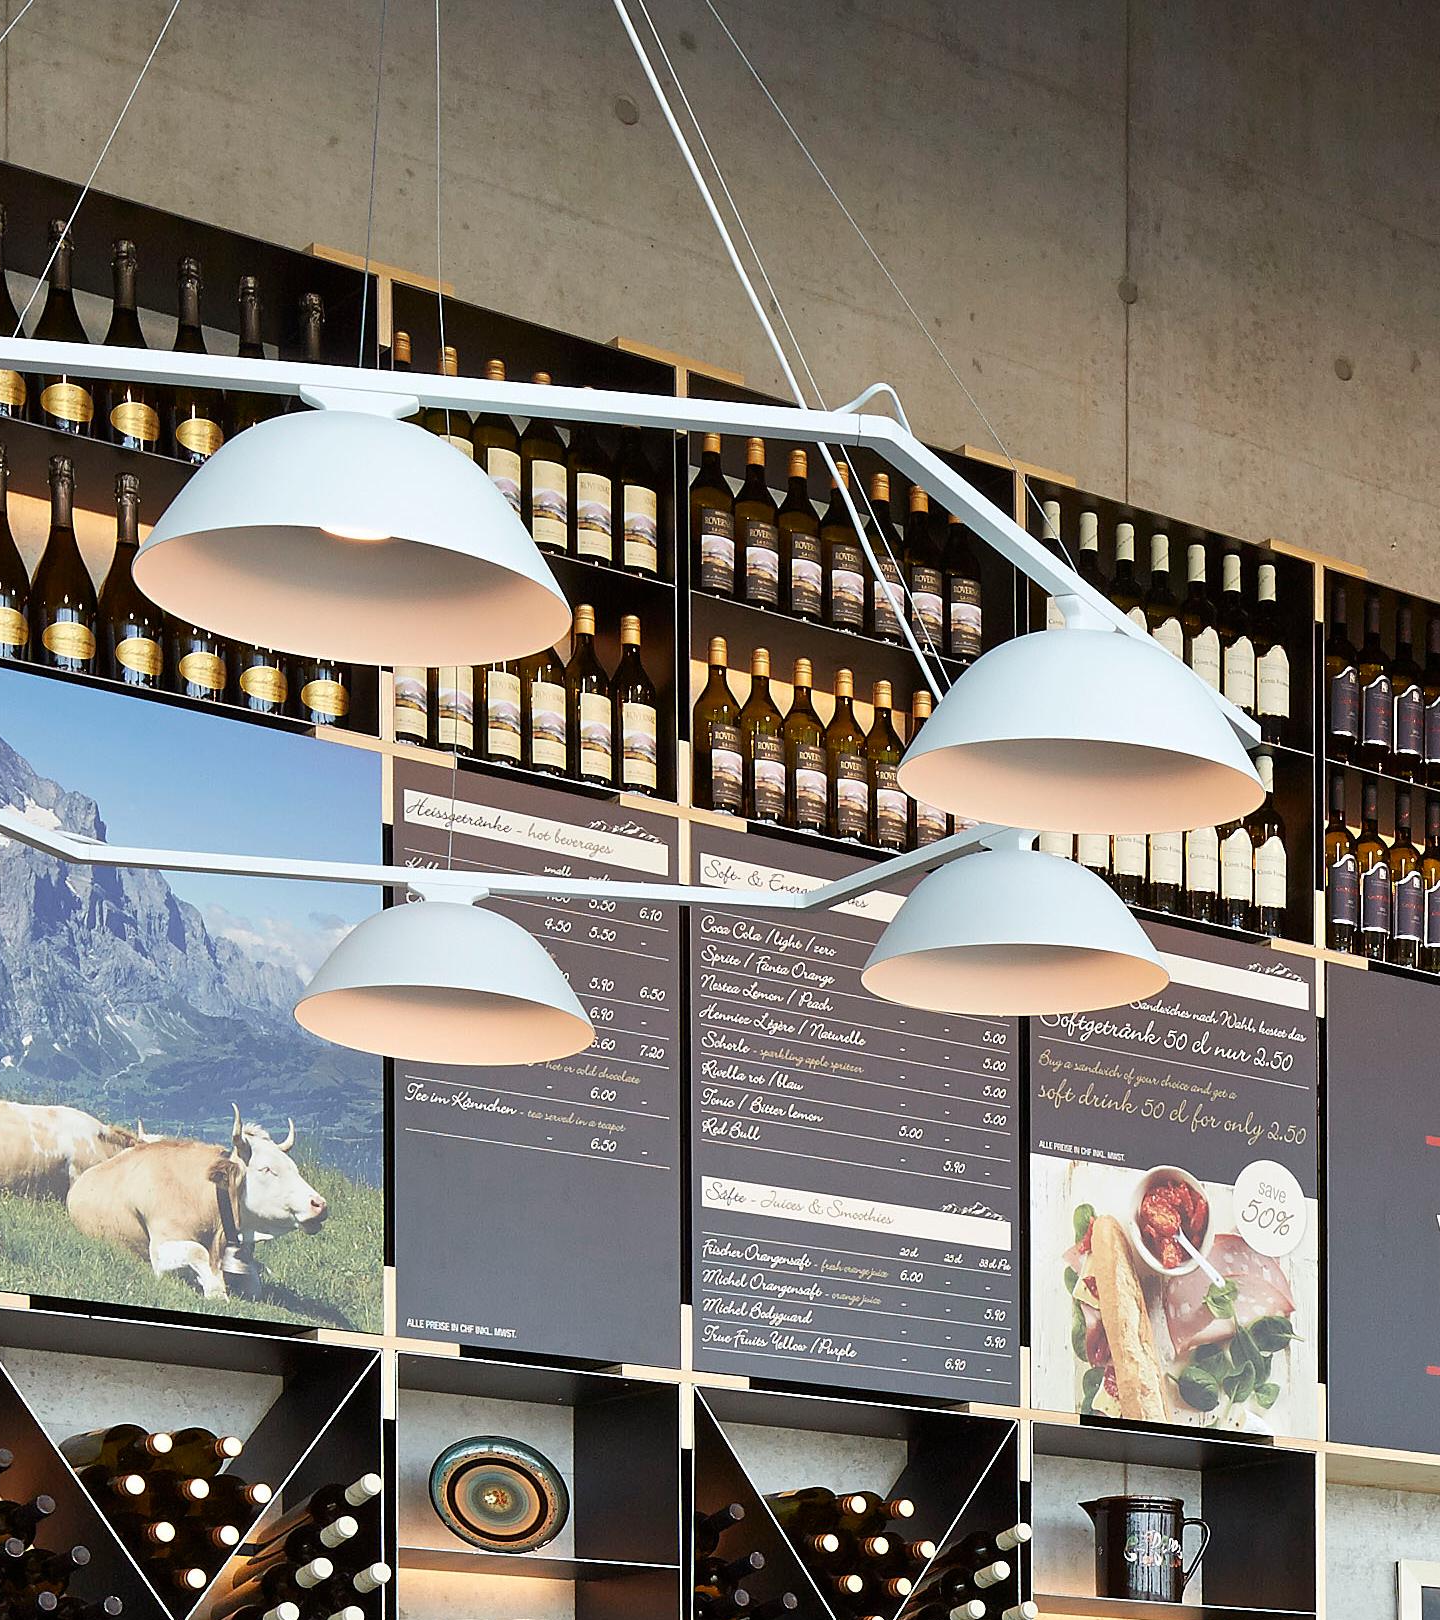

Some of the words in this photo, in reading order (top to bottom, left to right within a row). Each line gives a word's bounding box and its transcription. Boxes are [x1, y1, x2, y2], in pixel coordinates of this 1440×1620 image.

[406, 798, 512, 833] Heissgetränke
[527, 823, 552, 841] hot
[554, 829, 614, 856] beverages
[544, 866, 572, 877] small
[704, 860, 741, 880] Soft-
[589, 899, 616, 912] 5.50
[640, 908, 662, 921] 6.10
[545, 918, 571, 932] 4.50
[589, 927, 616, 941] 5.50
[701, 916, 730, 936] Coca
[732, 921, 762, 942] Cola
[701, 944, 741, 968] Sprite
[756, 955, 789, 976] Fanta
[792, 962, 836, 986] Orange
[589, 978, 614, 992] 5.90
[640, 987, 665, 1001] 6.50
[700, 975, 741, 995] Nestea
[742, 982, 784, 1003] Lemon
[799, 992, 834, 1012] Peach
[590, 1007, 613, 1020] 6.90
[1192, 1010, 1218, 1024] nach
[1259, 1021, 1286, 1039] kostet
[1288, 1029, 1307, 1043] das
[640, 1045, 664, 1059] 7.20
[810, 1024, 866, 1046] Naturelle
[983, 1058, 1006, 1072] 5.00
[983, 1031, 1006, 1044] 5.00
[1163, 1030, 1188, 1050] 50
[1214, 1047, 1251, 1062] nur
[1253, 1047, 1294, 1072] 2.50
[546, 1061, 562, 1072] hot
[576, 1064, 597, 1077] cold
[598, 1069, 640, 1084] chocolate
[702, 1031, 751, 1054] Schorle
[760, 1048, 804, 1066] sparkling
[805, 1057, 829, 1070] apple
[830, 1060, 865, 1073] spritzer
[983, 1085, 1006, 1099] 5.00
[1039, 1049, 1062, 1071] Buy
[1074, 1058, 1121, 1078] sandwich
[1124, 1067, 1135, 1084] of
[1135, 1074, 1160, 1087] your
[1161, 1074, 1190, 1091] choice
[1191, 1081, 1211, 1095] and
[1211, 1088, 1228, 1101] get
[405, 1083, 427, 1101] Tee
[430, 1094, 449, 1104] im
[451, 1092, 517, 1116] Kännchen
[528, 1108, 543, 1120] tea
[544, 1111, 574, 1125] served
[598, 1120, 626, 1134] teapot
[591, 1088, 616, 1101] 6.00
[702, 1060, 746, 1082] Rivella
[749, 1075, 765, 1085] rot
[983, 1113, 1007, 1126] 5.00
[701, 1088, 735, 1109] Tonic
[750, 1096, 786, 1116] Bitter
[789, 1107, 823, 1123] lemon
[899, 1126, 923, 1140] 5.00
[1038, 1079, 1076, 1109] soft
[1079, 1083, 1138, 1114] drink
[1141, 1100, 1165, 1119] 50
[1191, 1104, 1221, 1133] for
[1224, 1112, 1264, 1145] only
[1268, 1122, 1307, 1144] 2.50
[591, 1138, 617, 1152] 6.50
[702, 1117, 728, 1136] Red
[729, 1121, 760, 1142] Bull
[943, 1161, 965, 1174] 5.90
[1039, 1140, 1052, 1150] ALLE
[1053, 1142, 1073, 1153] PREISE
[1080, 1146, 1092, 1156] CHF
[706, 1182, 746, 1206] Säfte
[760, 1192, 803, 1213] Juices
[826, 1203, 895, 1225] Smoothies
[1259, 1180, 1286, 1204] save
[1242, 1199, 1295, 1236] 50%
[702, 1239, 744, 1260] Frischer
[745, 1244, 811, 1270] Orangensaft
[900, 1270, 923, 1283] 6.00
[703, 1270, 747, 1289] Michel
[750, 1274, 823, 1299] Orangensaft
[984, 1309, 1006, 1322] 5.90
[407, 1318, 424, 1328] ALLE
[426, 1320, 450, 1331] PREISE
[451, 1324, 459, 1332] IN
[460, 1324, 474, 1334] CHF
[703, 1298, 748, 1318] Michel
[749, 1305, 812, 1327] Bodyguard
[984, 1336, 1006, 1349] 5.90
[702, 1325, 732, 1345] True
[733, 1329, 768, 1348] Fruits
[770, 1334, 807, 1354] Yellow
[945, 1359, 966, 1371] 6.90
